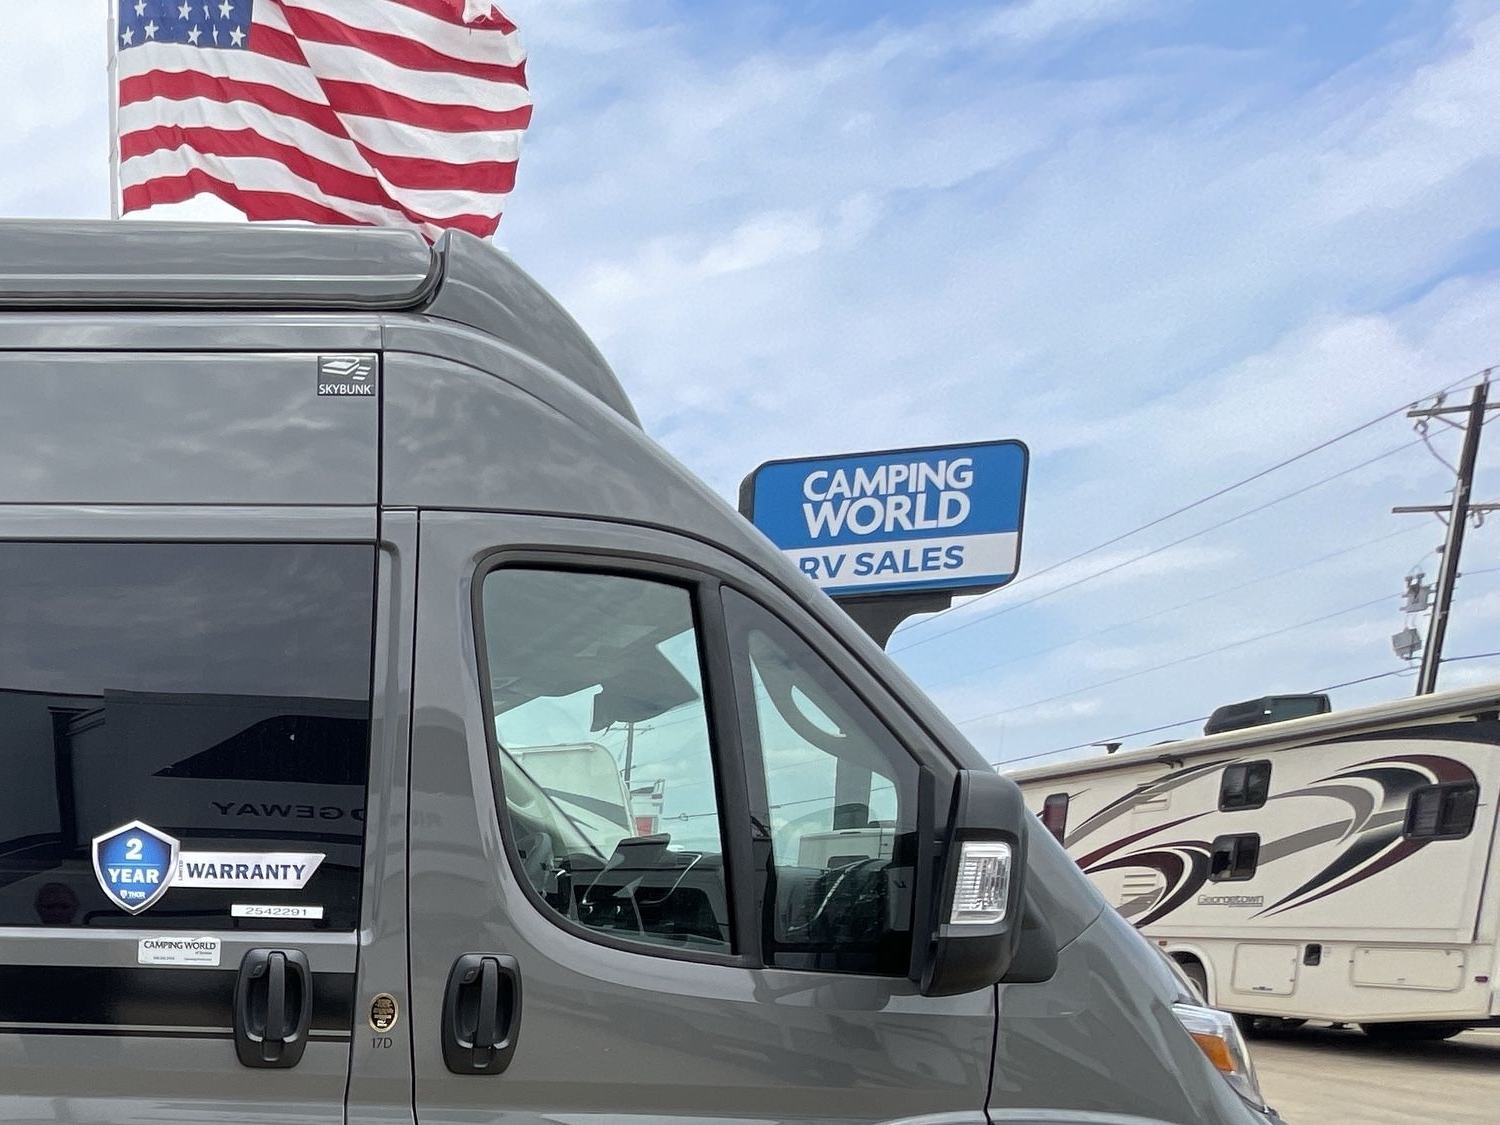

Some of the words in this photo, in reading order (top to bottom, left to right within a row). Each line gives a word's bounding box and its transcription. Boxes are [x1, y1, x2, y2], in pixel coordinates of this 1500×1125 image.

[319, 384, 372, 395] SKYBUNK
[803, 457, 975, 502] CAMPING
[802, 490, 971, 539] WORLD
[799, 554, 846, 580] RV
[853, 545, 965, 577] SALES
[125, 838, 143, 860] 2
[108, 868, 160, 884] YEAR
[186, 863, 306, 880] WARRANTY
[128, 890, 146, 899] THOR
[245, 907, 307, 916] 2542291
[144, 941, 183, 949] CAMPING
[184, 942, 217, 950] WORLD
[372, 1037, 393, 1049] 17D
